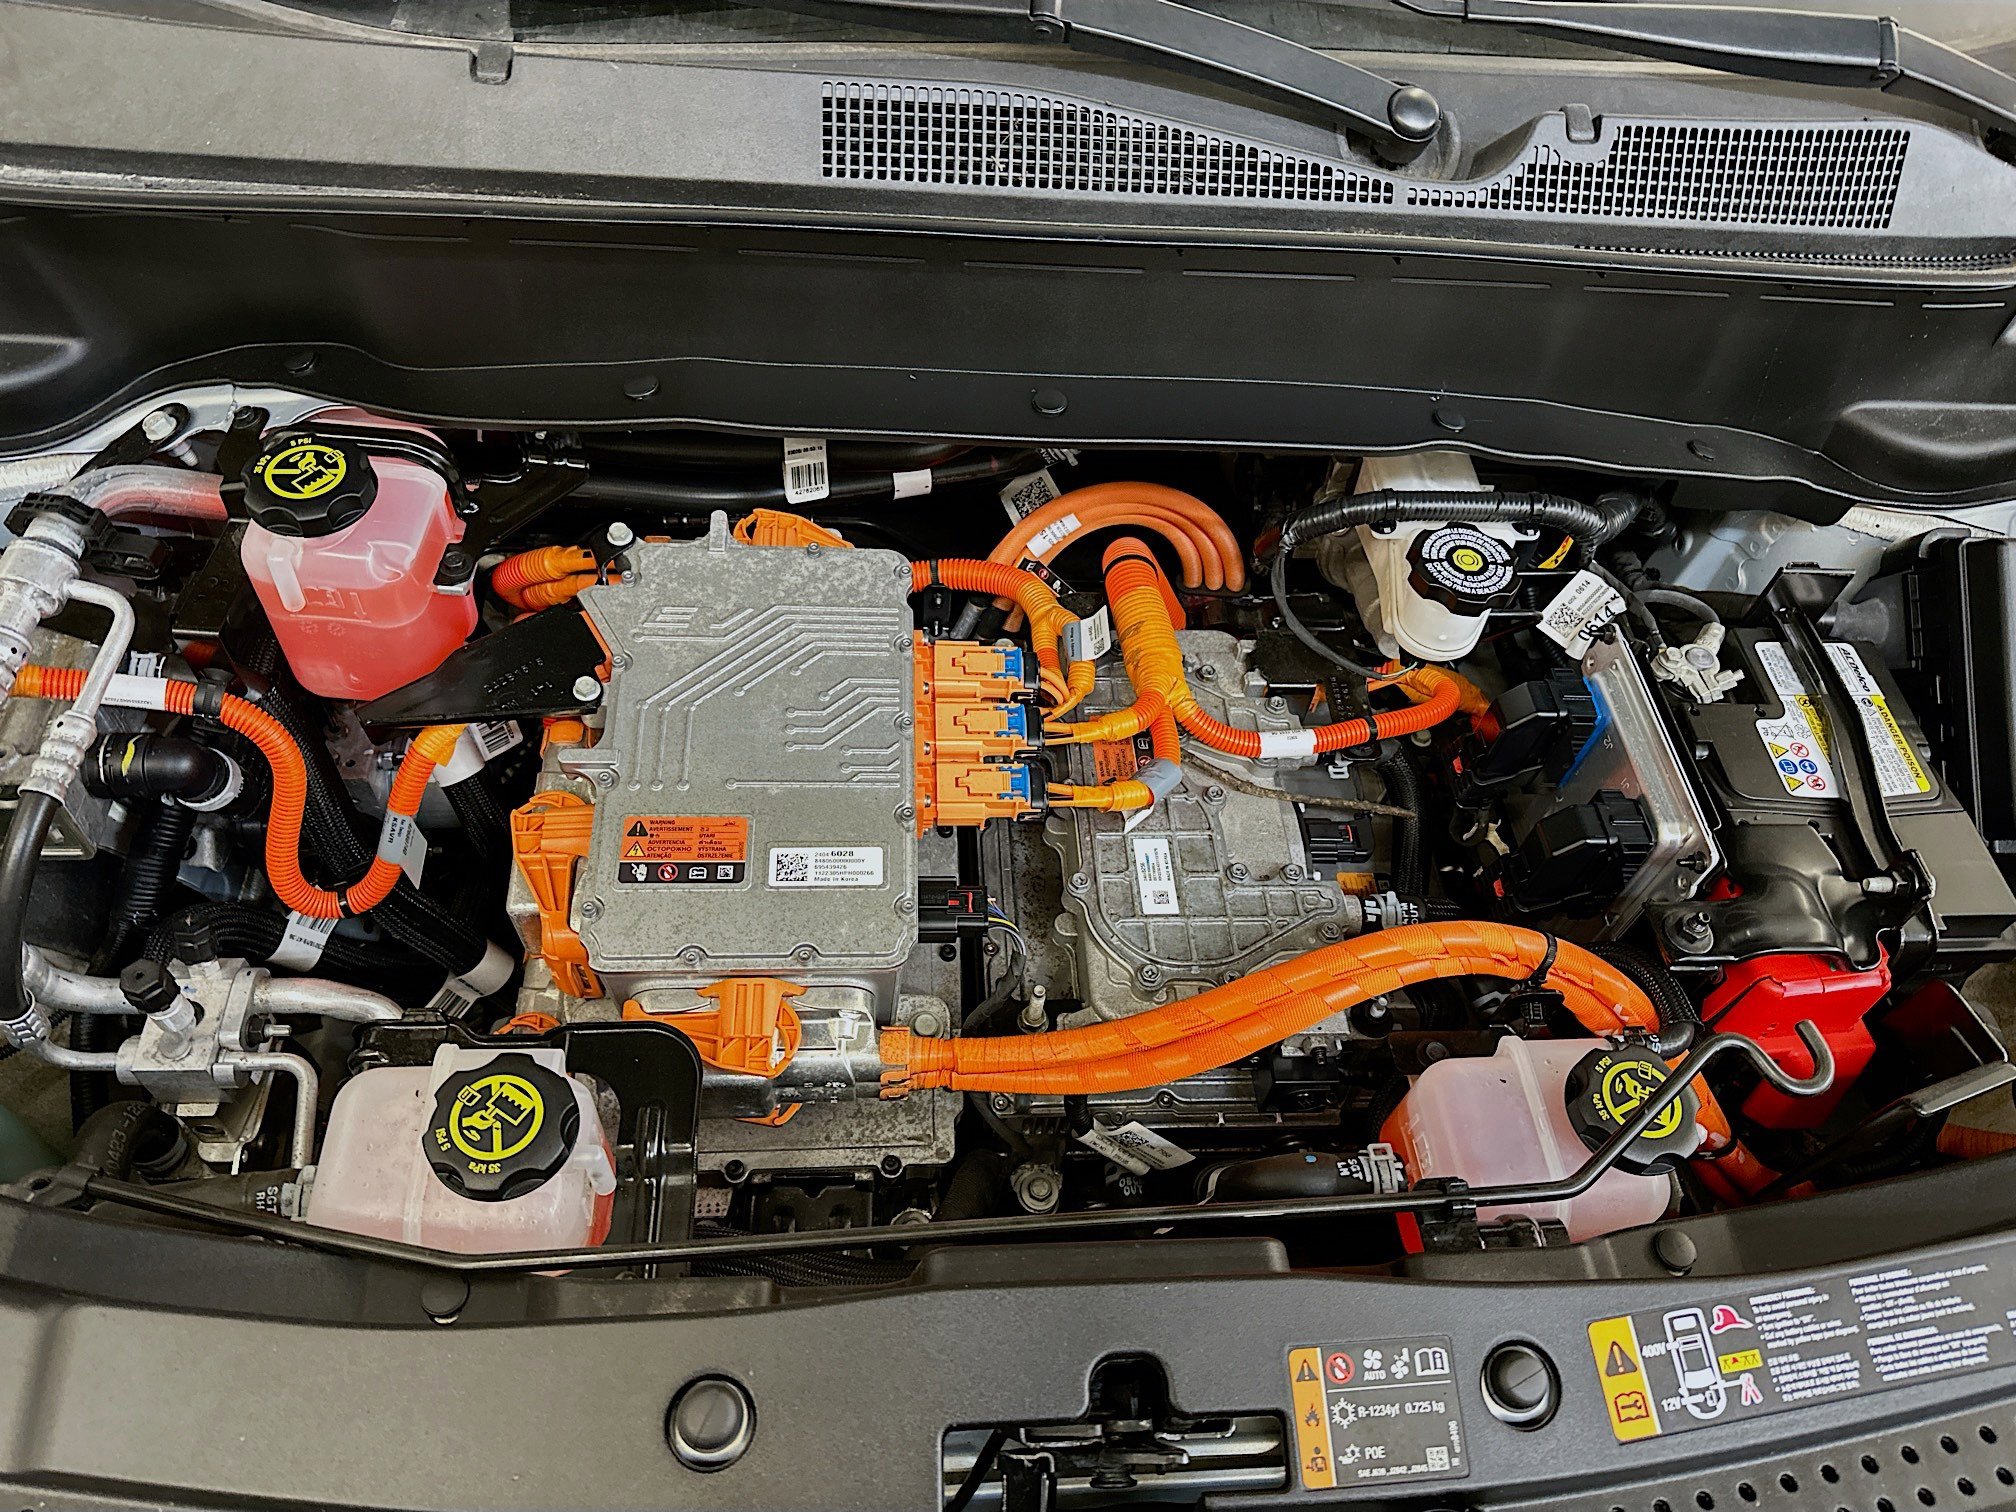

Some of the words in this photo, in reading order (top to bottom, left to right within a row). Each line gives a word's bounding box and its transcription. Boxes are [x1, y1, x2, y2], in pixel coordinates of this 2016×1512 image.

[388, 816, 398, 844] KSAVR
[1594, 1064, 1604, 1074] 5
[1599, 1056, 1612, 1070] PSI
[436, 1128, 448, 1145] PSI
[440, 1144, 452, 1152] 5
[488, 1163, 501, 1174] 35
[1347, 1158, 1364, 1180] SGT
[256, 1192, 266, 1210] RH
[266, 1186, 278, 1214] SGT
[1641, 1342, 1667, 1359] 400V
[1364, 1370, 1386, 1381] AUTO
[1358, 1403, 1400, 1418] R-1234yf
[1405, 1402, 1430, 1414] 0.725
[1432, 1400, 1445, 1413] kg
[1661, 1396, 1682, 1412] 12V
[1365, 1446, 1386, 1460] POE
